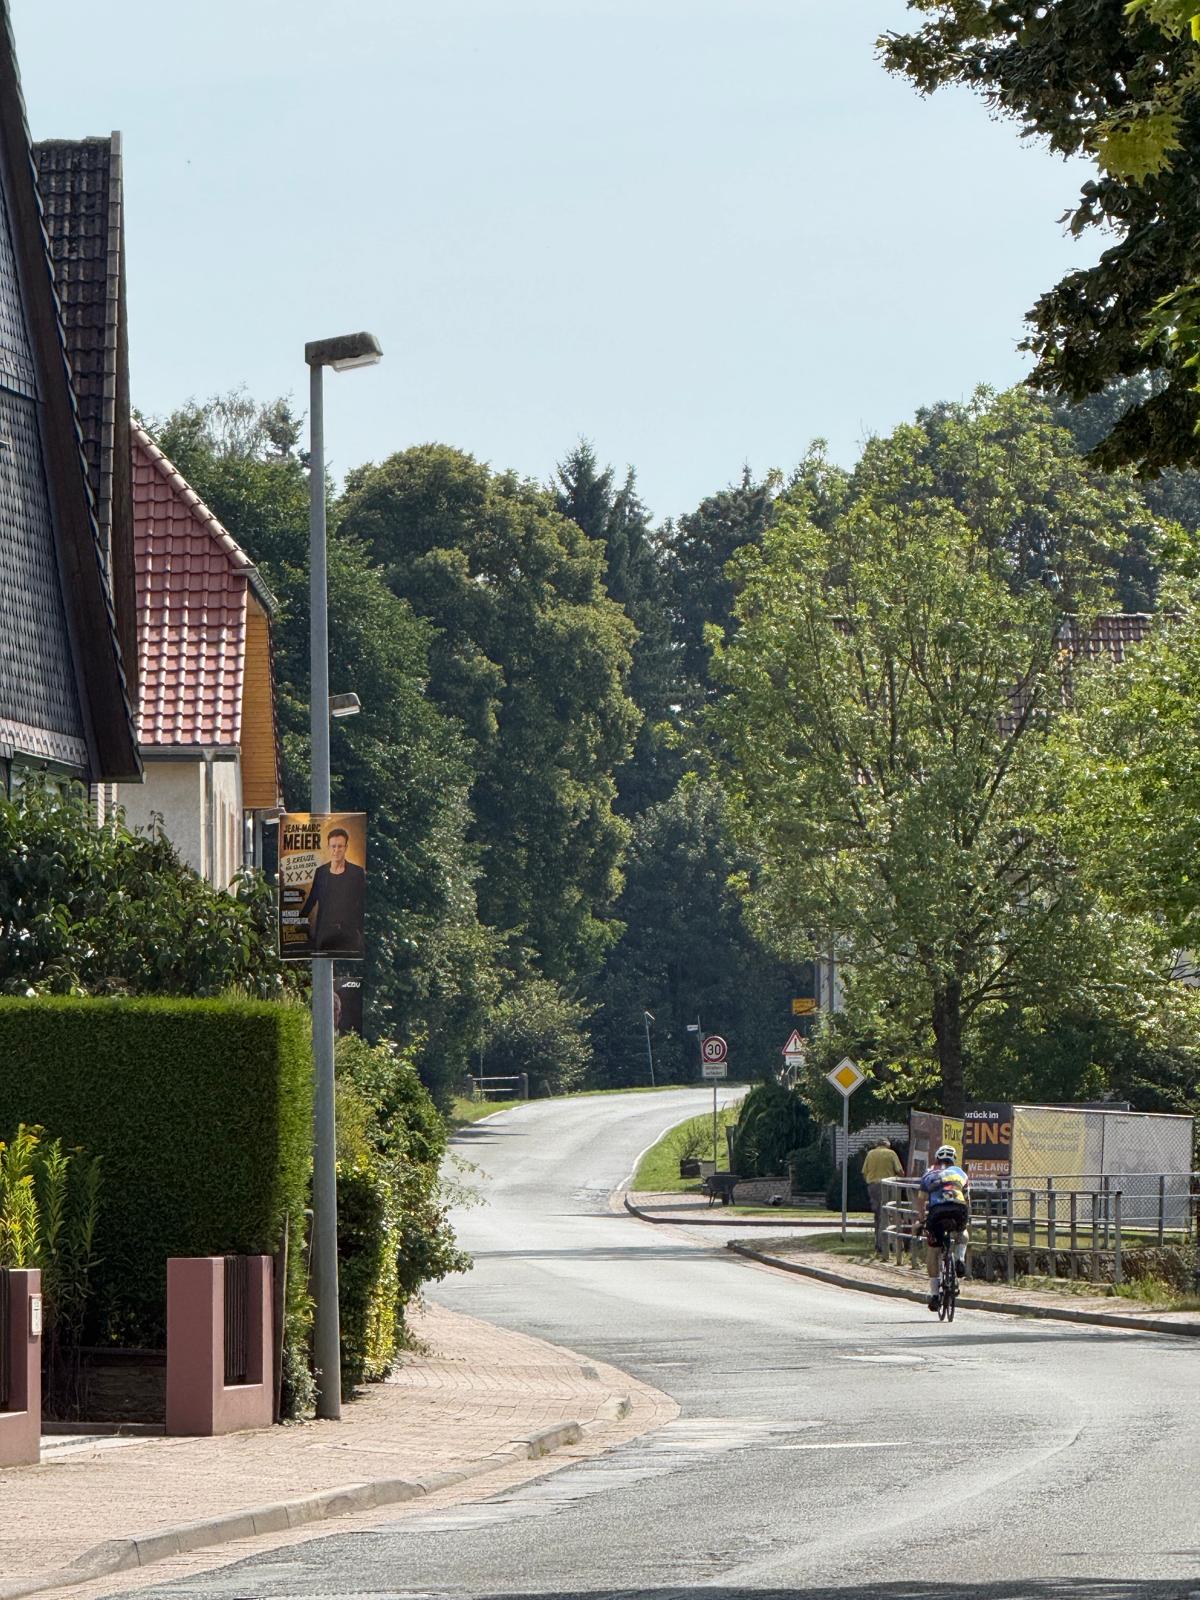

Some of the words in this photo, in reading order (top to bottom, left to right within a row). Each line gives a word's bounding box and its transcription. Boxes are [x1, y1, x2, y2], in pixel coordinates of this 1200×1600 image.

[284, 823, 321, 833] JEAN-MARC
[284, 833, 321, 850] MEIER
[286, 857, 291, 866] 3
[292, 854, 315, 863] KREUZE
[346, 981, 361, 989] CDU
[707, 1044, 720, 1056] 30
[989, 1110, 999, 1119] im
